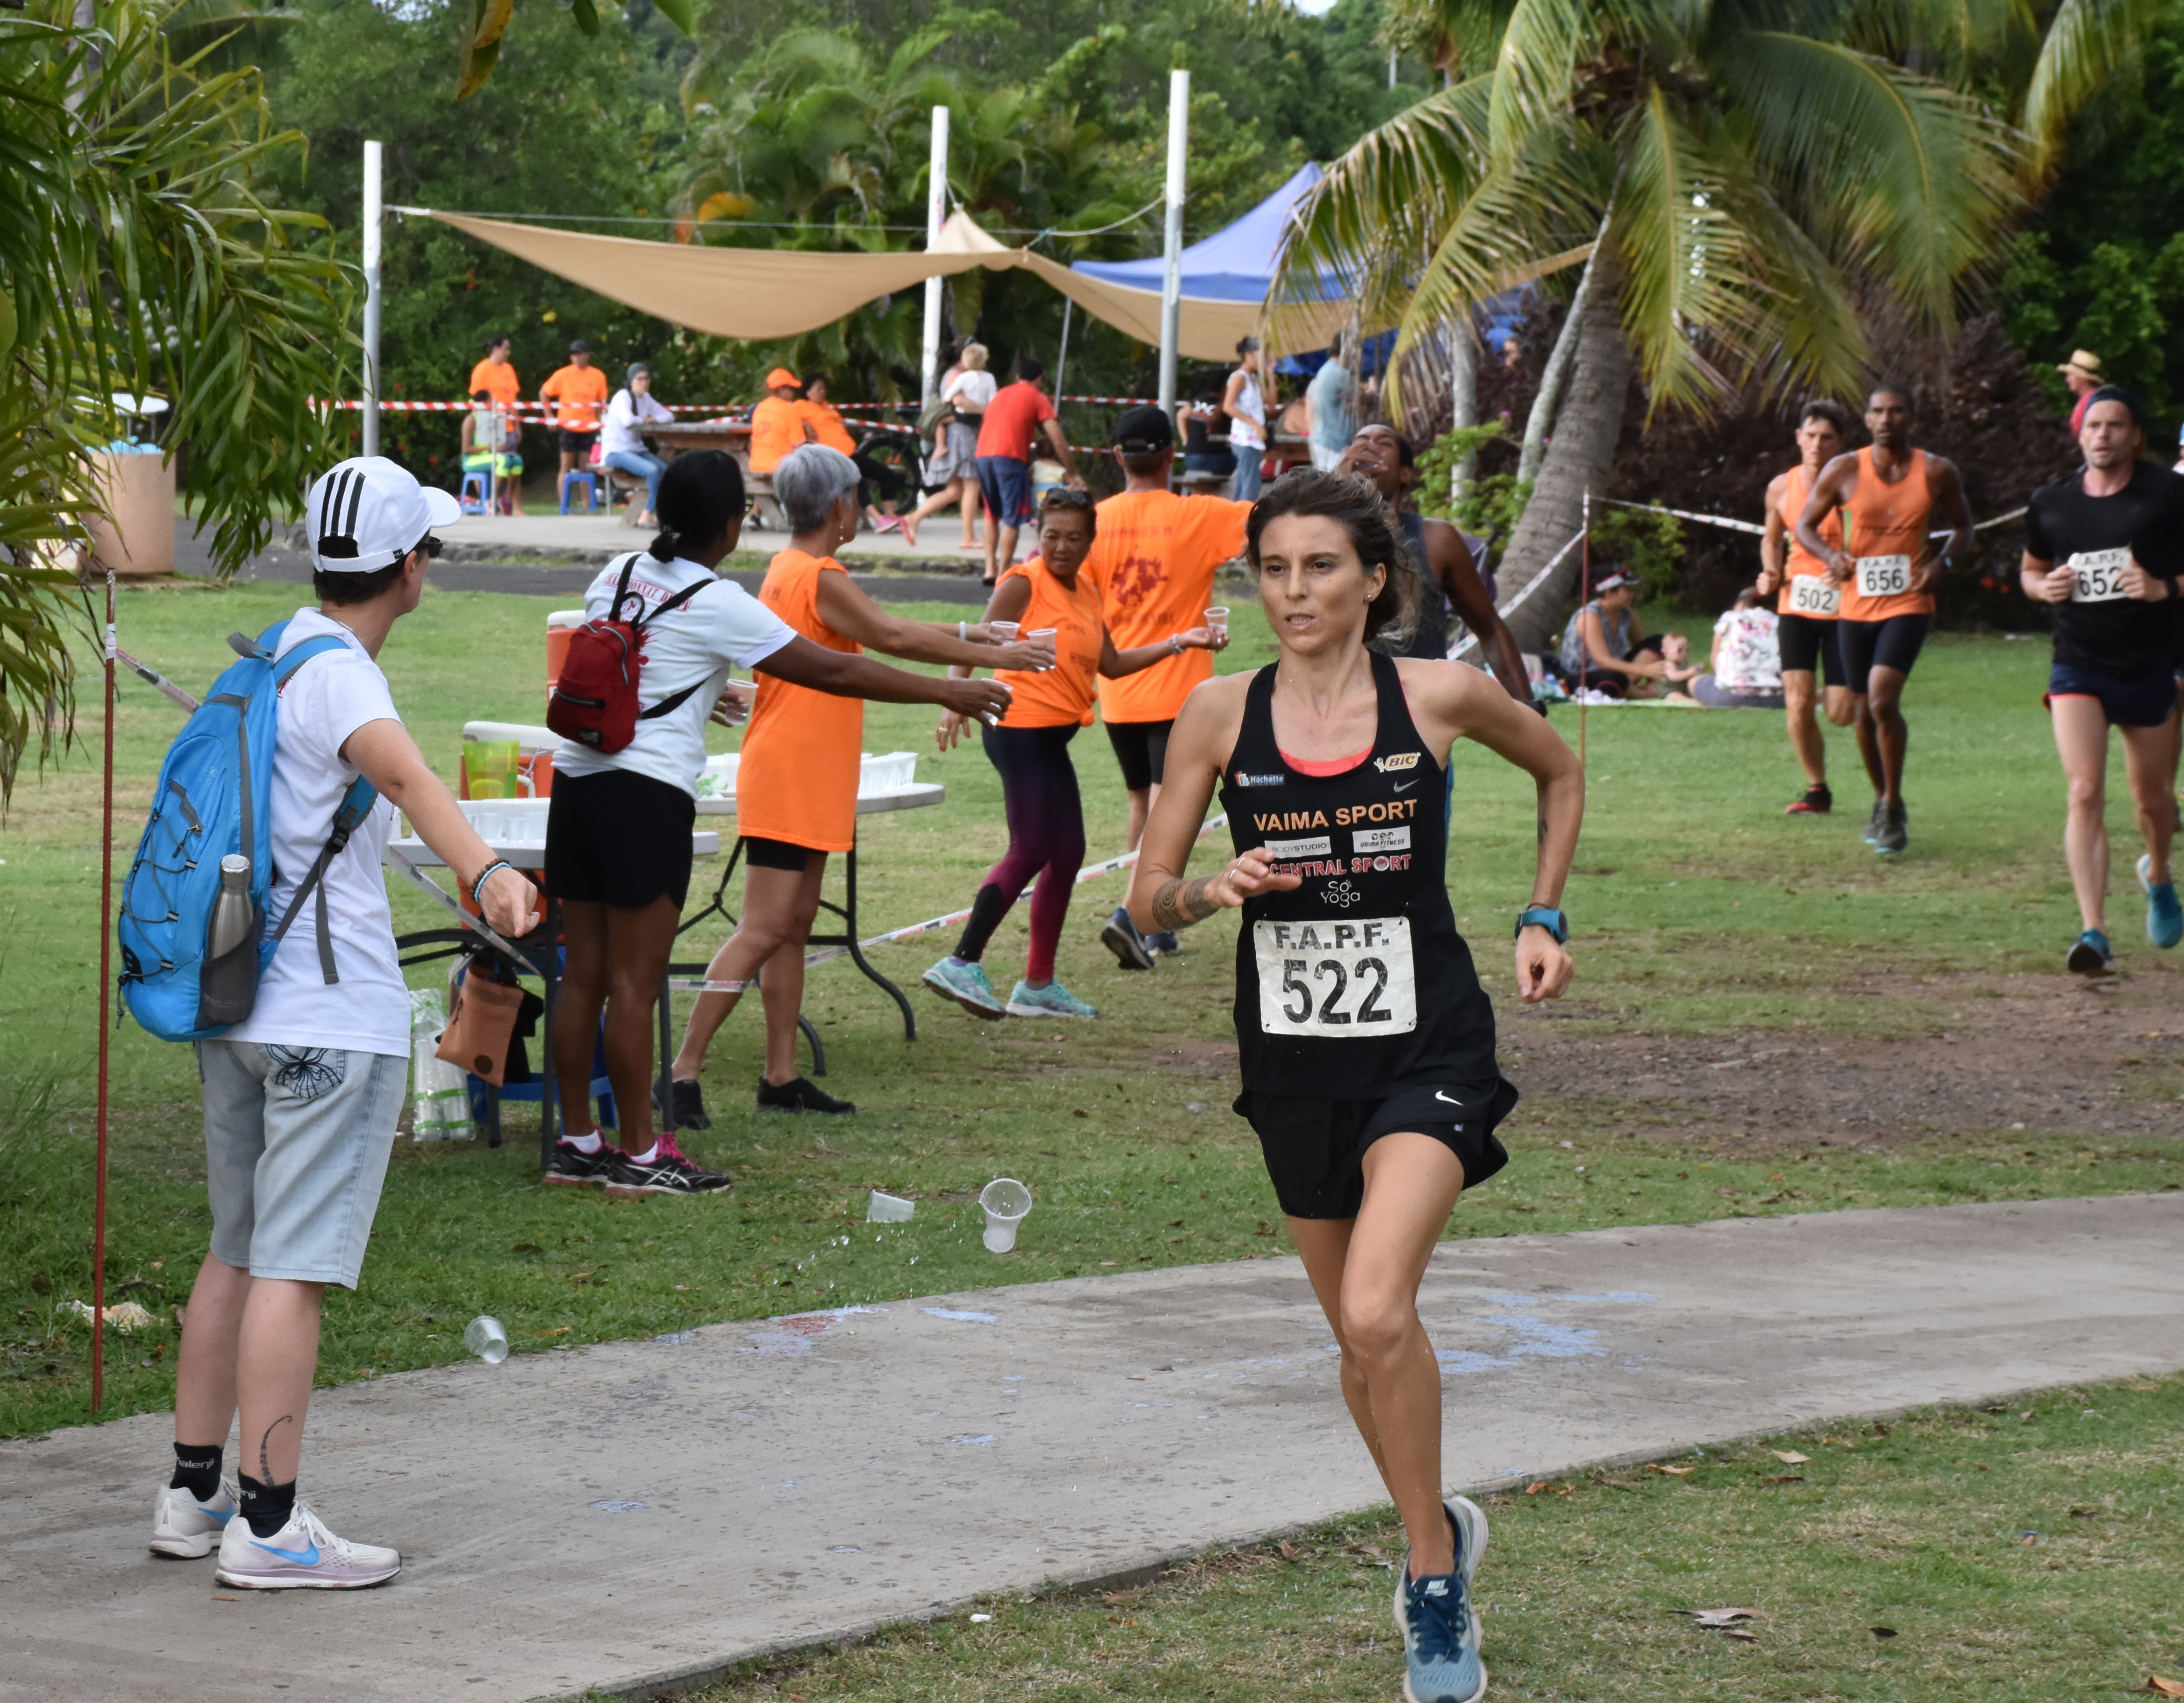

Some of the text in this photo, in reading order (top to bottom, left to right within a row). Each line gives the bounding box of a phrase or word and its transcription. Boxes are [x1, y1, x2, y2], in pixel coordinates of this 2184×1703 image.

[1866, 568, 1903, 591] 656
[2078, 566, 2123, 596] 652
[1797, 587, 1833, 610] 502
[1389, 755, 1416, 767] BIC
[1250, 775, 1284, 783] Hachette
[1253, 798, 1418, 831] VAIMA SPORT
[1270, 853, 1412, 877] CENTRAL SPORT
[1320, 892, 1360, 908] Yoga
[1274, 922, 1390, 949] F.A.P.F.
[1282, 957, 1392, 1025] 522
